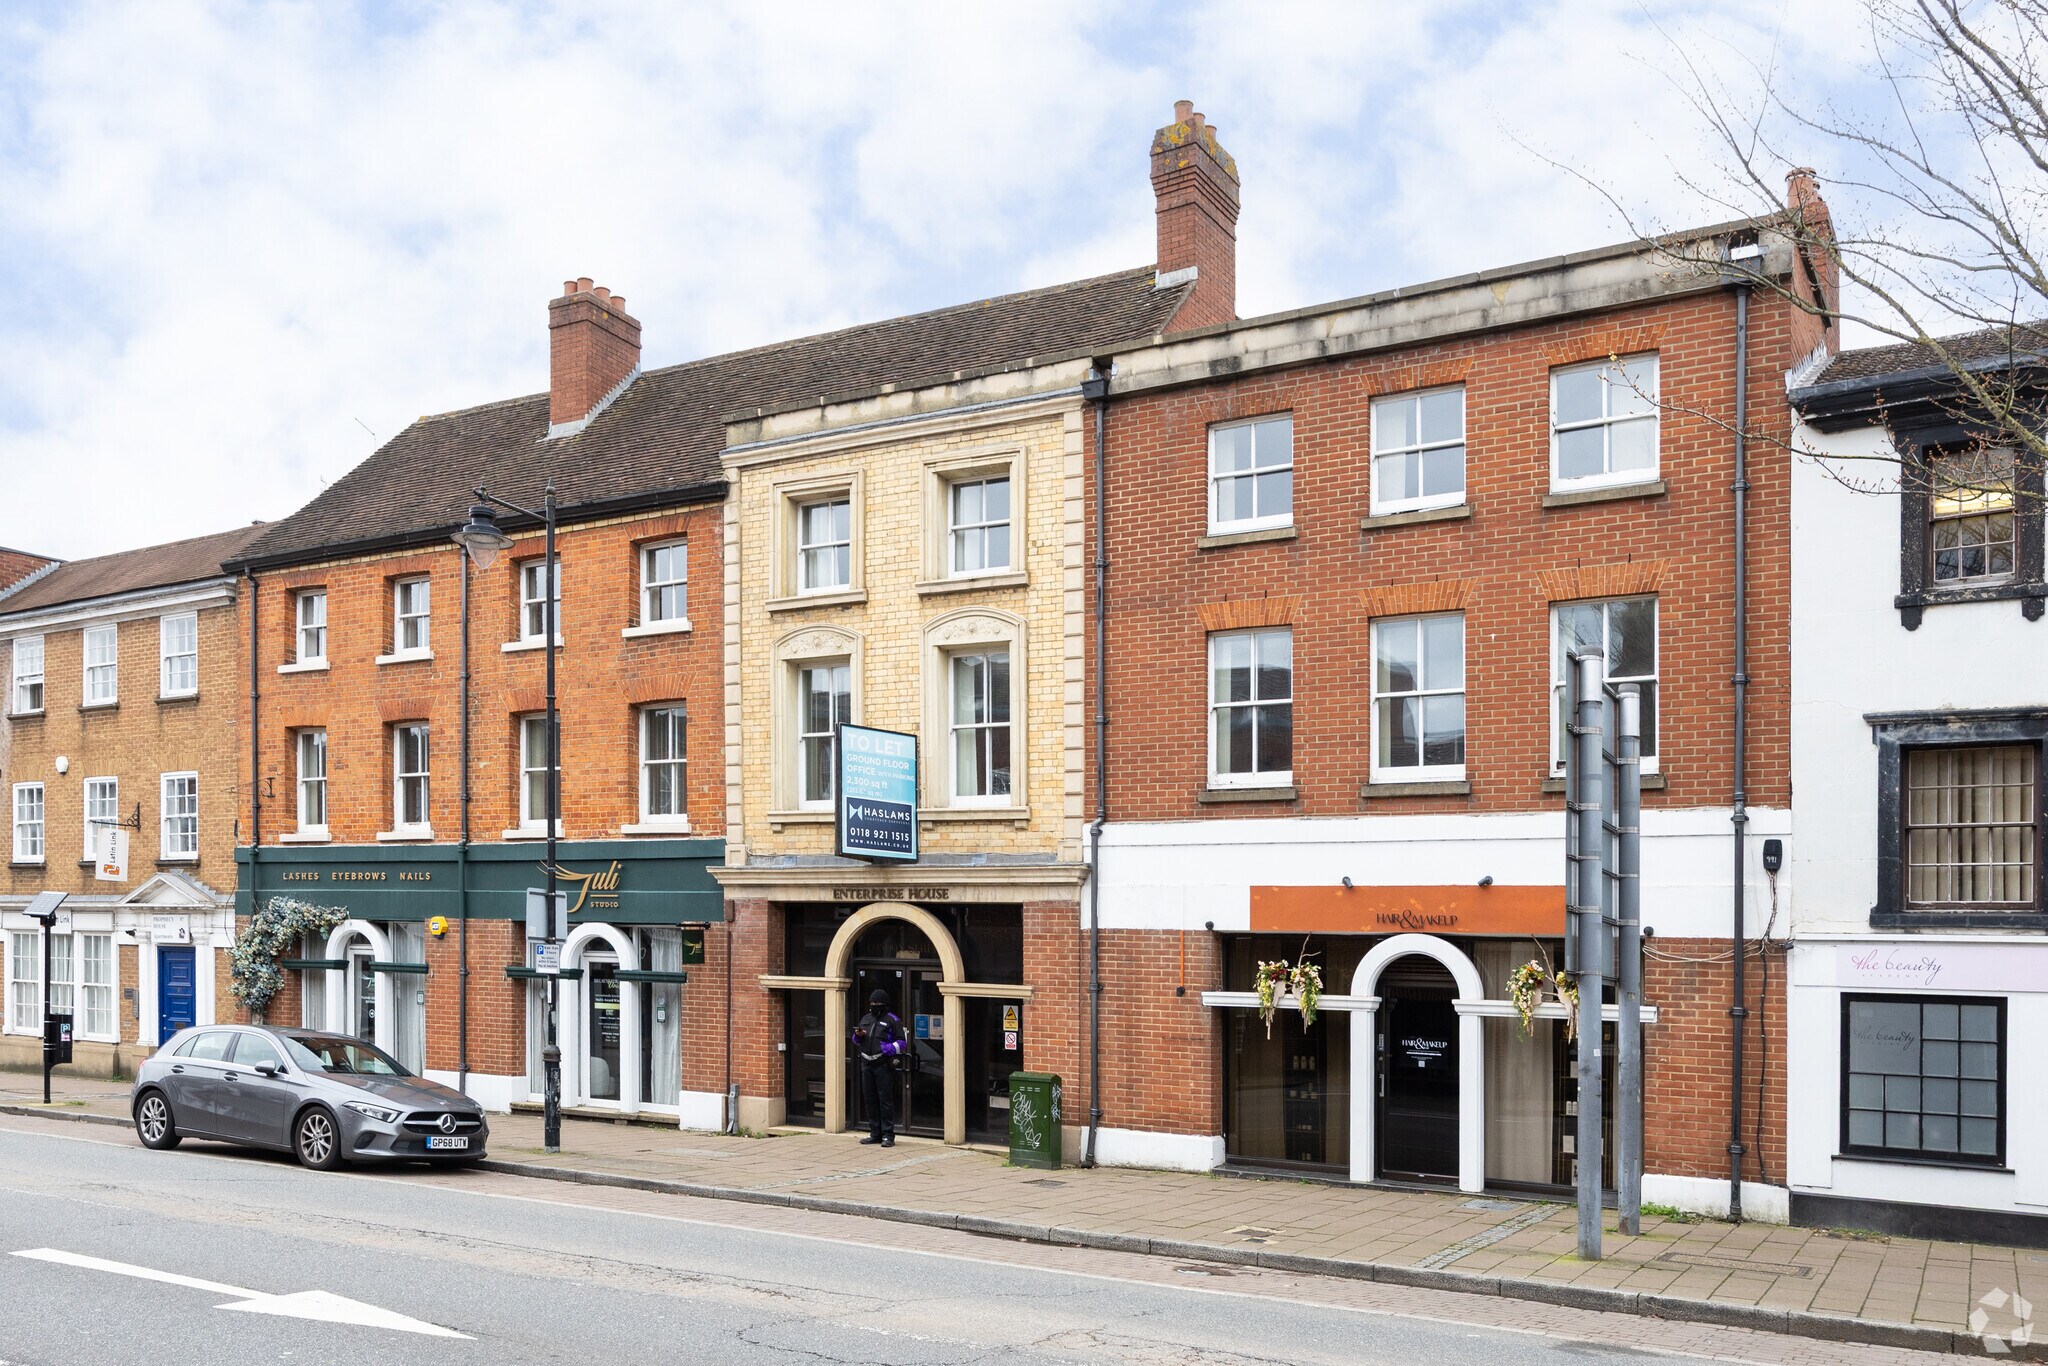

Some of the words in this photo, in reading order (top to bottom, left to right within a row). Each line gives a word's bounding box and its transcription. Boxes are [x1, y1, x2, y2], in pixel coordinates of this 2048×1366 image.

[847, 733, 870, 751] TO
[874, 738, 904, 756] LET
[846, 753, 882, 766] GROUND
[883, 758, 910, 770] FLOOR
[846, 764, 876, 776] OFFICE
[877, 771, 892, 779] WITH
[892, 772, 915, 782] PARKING
[846, 776, 869, 786] 2,300
[871, 781, 880, 789] sq
[881, 781, 888, 789] ft
[864, 807, 911, 821] HASLAMS
[850, 827, 870, 838] 0118
[873, 829, 888, 839] 921
[891, 832, 910, 842] 1515
[850, 838, 910, 849] WWW.HASLAMS.CO.UK
[282, 871, 320, 881] LASHES
[331, 871, 387, 881] EYEBROWS
[399, 871, 431, 881] NAILS
[832, 888, 904, 900] ENTERPRISE
[908, 888, 950, 900] HOUSE
[1851, 949, 1878, 970] the
[1885, 948, 1943, 986] beauty
[1876, 1025, 1915, 1051] beauty
[432, 1138, 453, 1148] GP68
